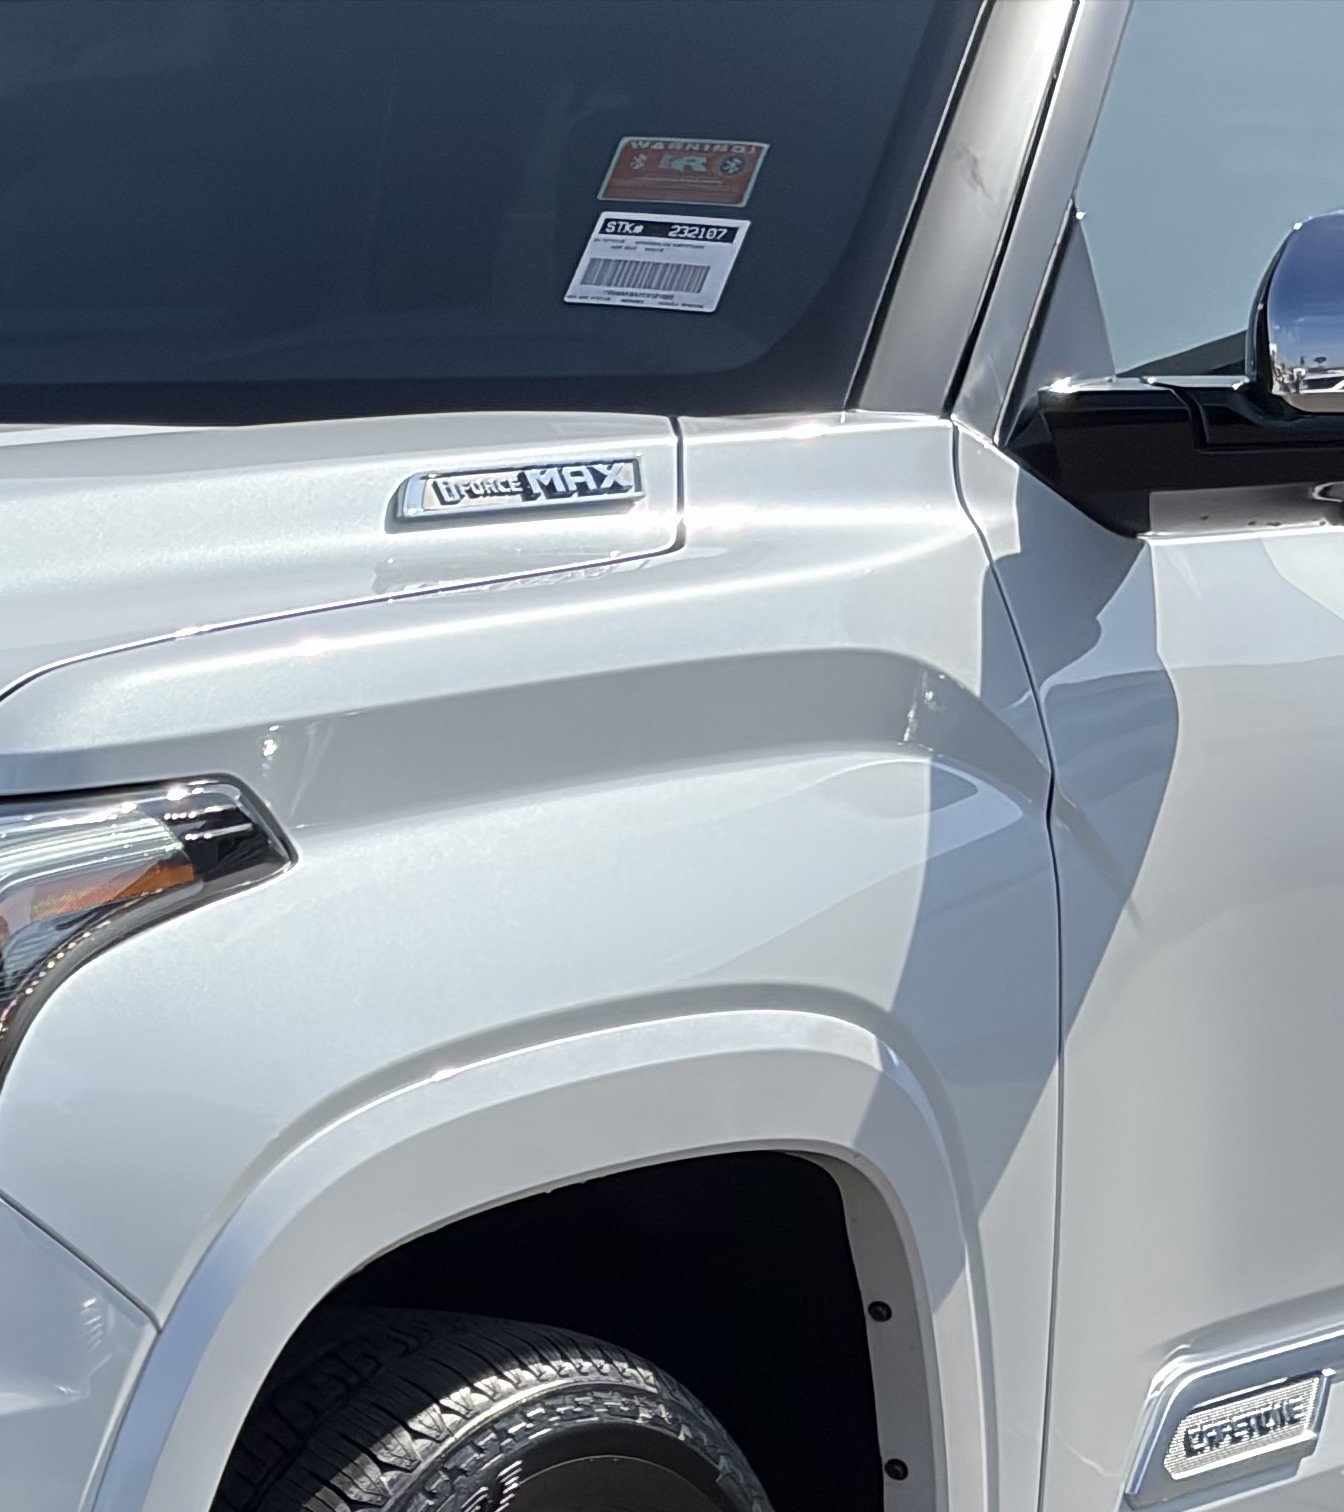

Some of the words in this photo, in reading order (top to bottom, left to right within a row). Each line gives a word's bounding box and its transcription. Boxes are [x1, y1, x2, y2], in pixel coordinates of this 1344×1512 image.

[604, 220, 644, 234] STK#
[667, 224, 728, 241] 232107
[525, 462, 634, 500] MAX
